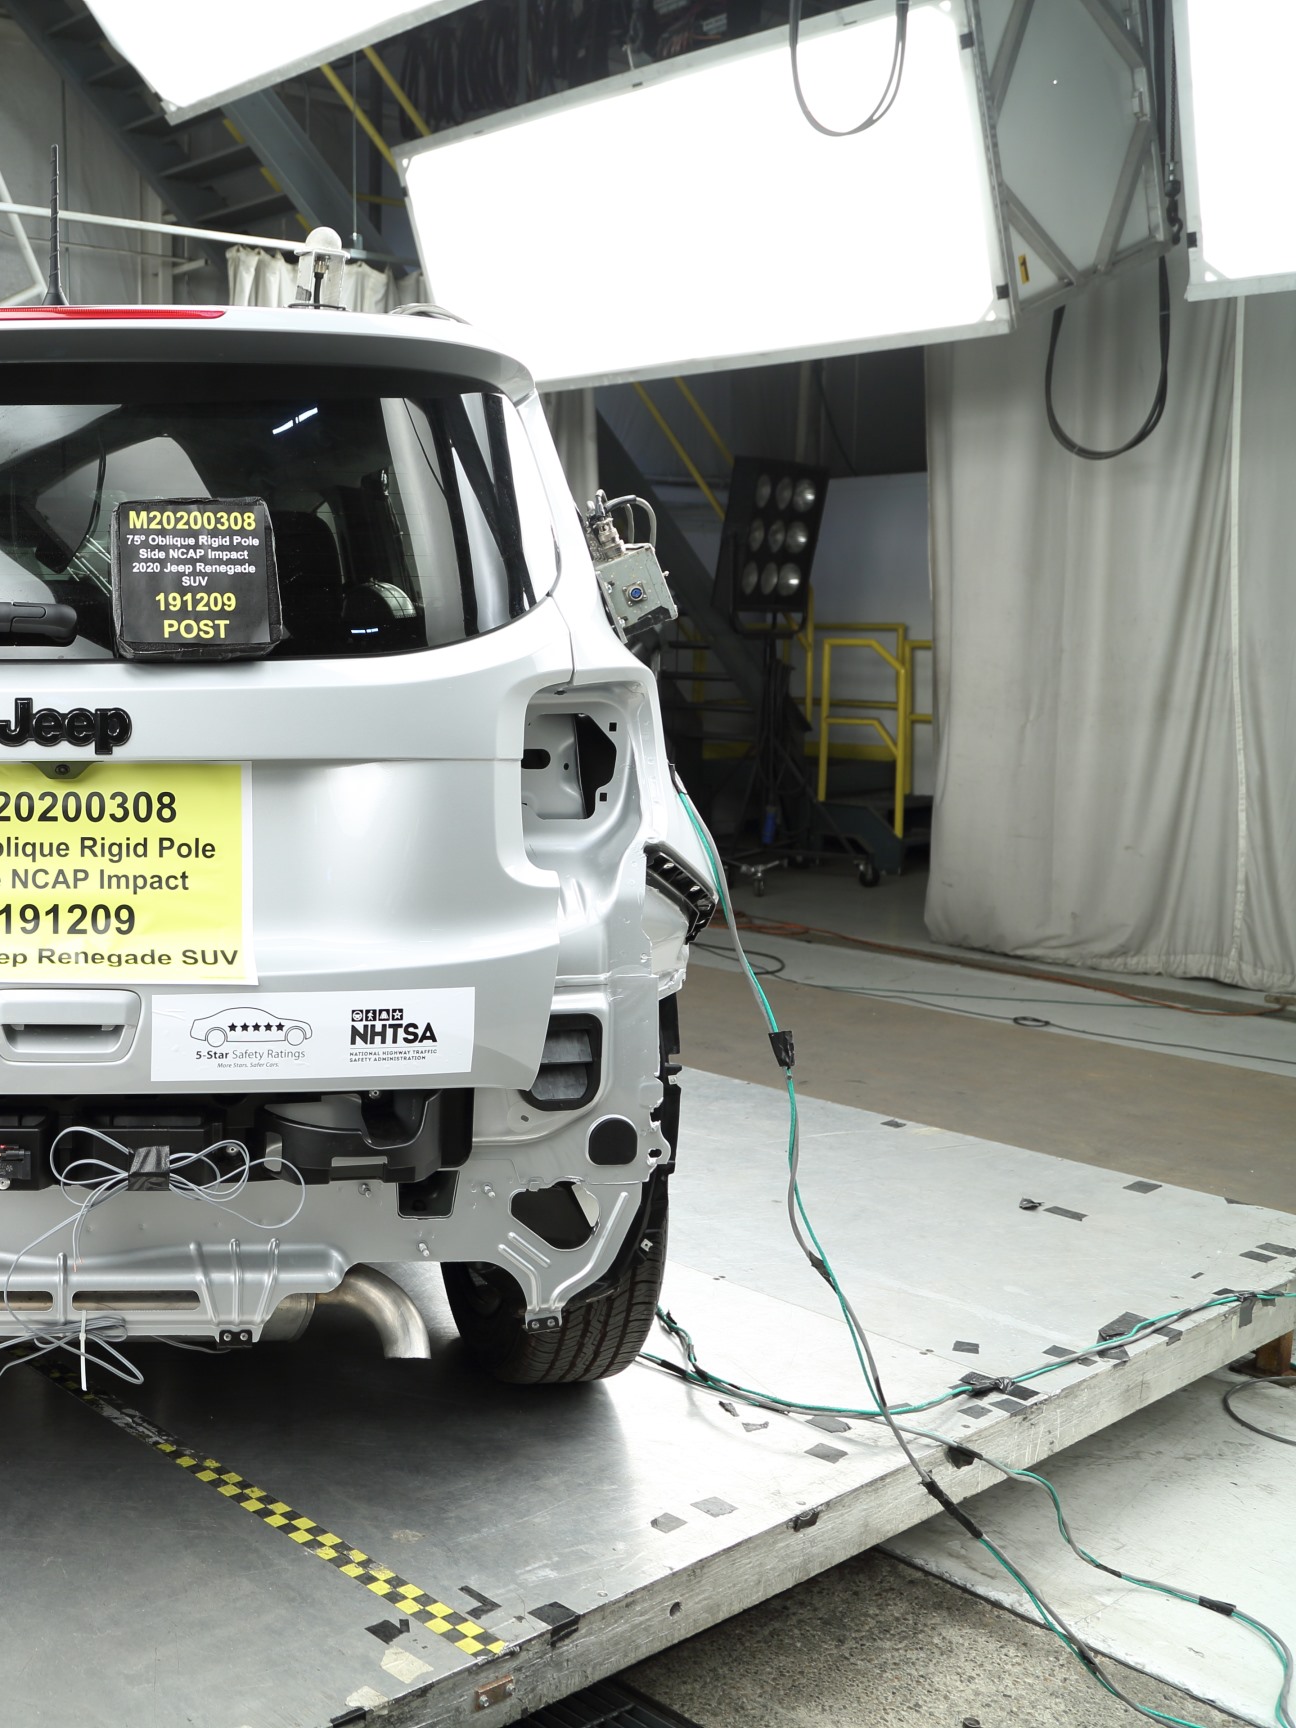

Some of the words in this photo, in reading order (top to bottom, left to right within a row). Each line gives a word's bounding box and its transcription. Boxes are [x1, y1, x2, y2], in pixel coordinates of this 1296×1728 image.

[129, 511, 256, 530] M20200308
[149, 535, 195, 547] Oblique
[199, 536, 229, 547] Rigid
[233, 537, 259, 546] Pole
[139, 549, 165, 559] Side
[169, 549, 204, 559] NCAP
[208, 550, 248, 561] Impact
[133, 563, 160, 572] 2020
[164, 563, 193, 574] Jeep
[196, 563, 256, 574] Renegade
[182, 577, 208, 586] SUV
[156, 592, 236, 611] 191209
[163, 620, 230, 638] POST
[80, 837, 148, 863] Rigid
[158, 837, 216, 858] Pole
[11, 869, 90, 889] NCAP
[99, 869, 189, 895] Impact
[38, 948, 172, 967] Renegade
[182, 949, 239, 965] SUV
[350, 1022, 437, 1045] NHTSA
[196, 1051, 229, 1059] 5-Star
[232, 1050, 264, 1060] Safety
[267, 1049, 305, 1060] Ratings
